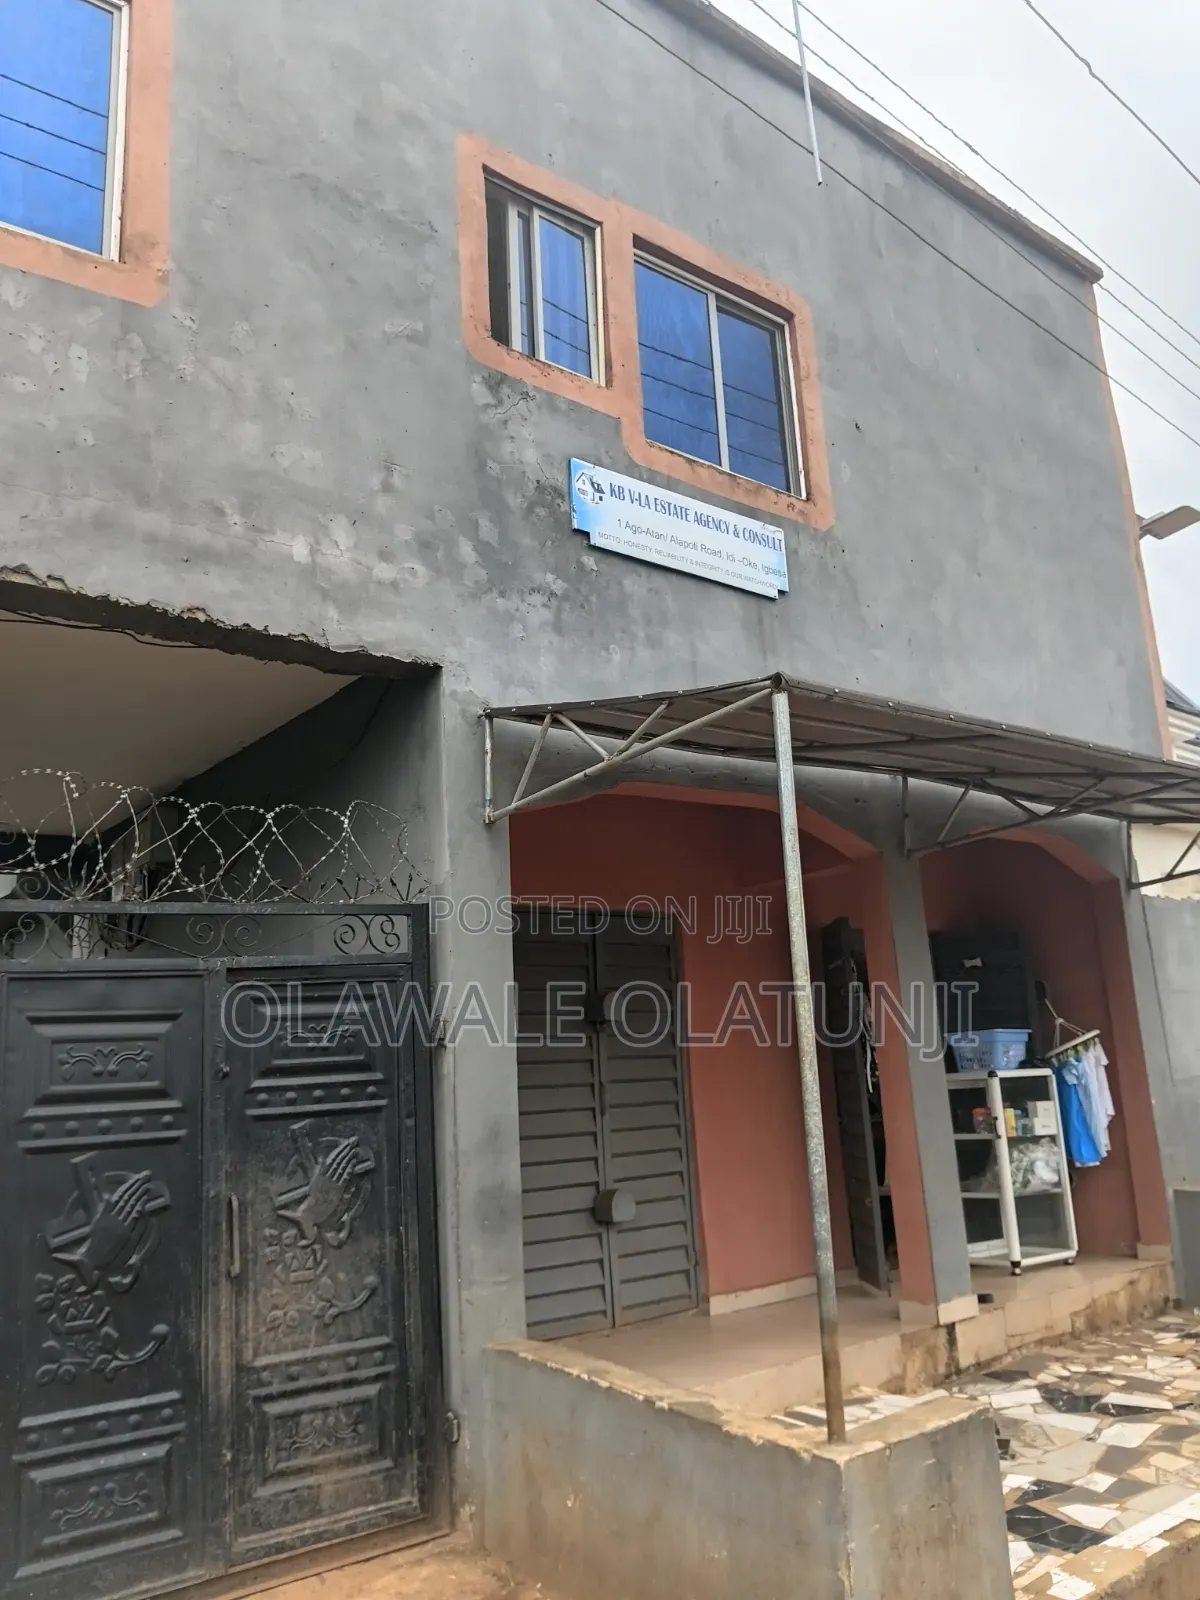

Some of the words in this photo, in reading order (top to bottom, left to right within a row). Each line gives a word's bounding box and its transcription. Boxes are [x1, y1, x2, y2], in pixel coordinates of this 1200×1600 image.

[609, 482, 626, 501] KB
[628, 488, 651, 510] V-LA
[654, 497, 691, 522] ESTATE
[693, 511, 730, 535] AGENCY
[732, 524, 740, 539] &
[742, 527, 782, 552] CONSULT
[617, 518, 622, 528] 1
[624, 520, 668, 542] Ago-Atan/
[669, 535, 699, 552] Alapoti
[700, 543, 724, 561] Road,
[726, 552, 736, 563] Idi
[761, 563, 787, 579] Igbesa
[654, 548, 689, 564] RELIABILITY
[689, 558, 695, 566] &
[694, 560, 724, 574] INTEGRITY
[730, 571, 743, 580] OUR
